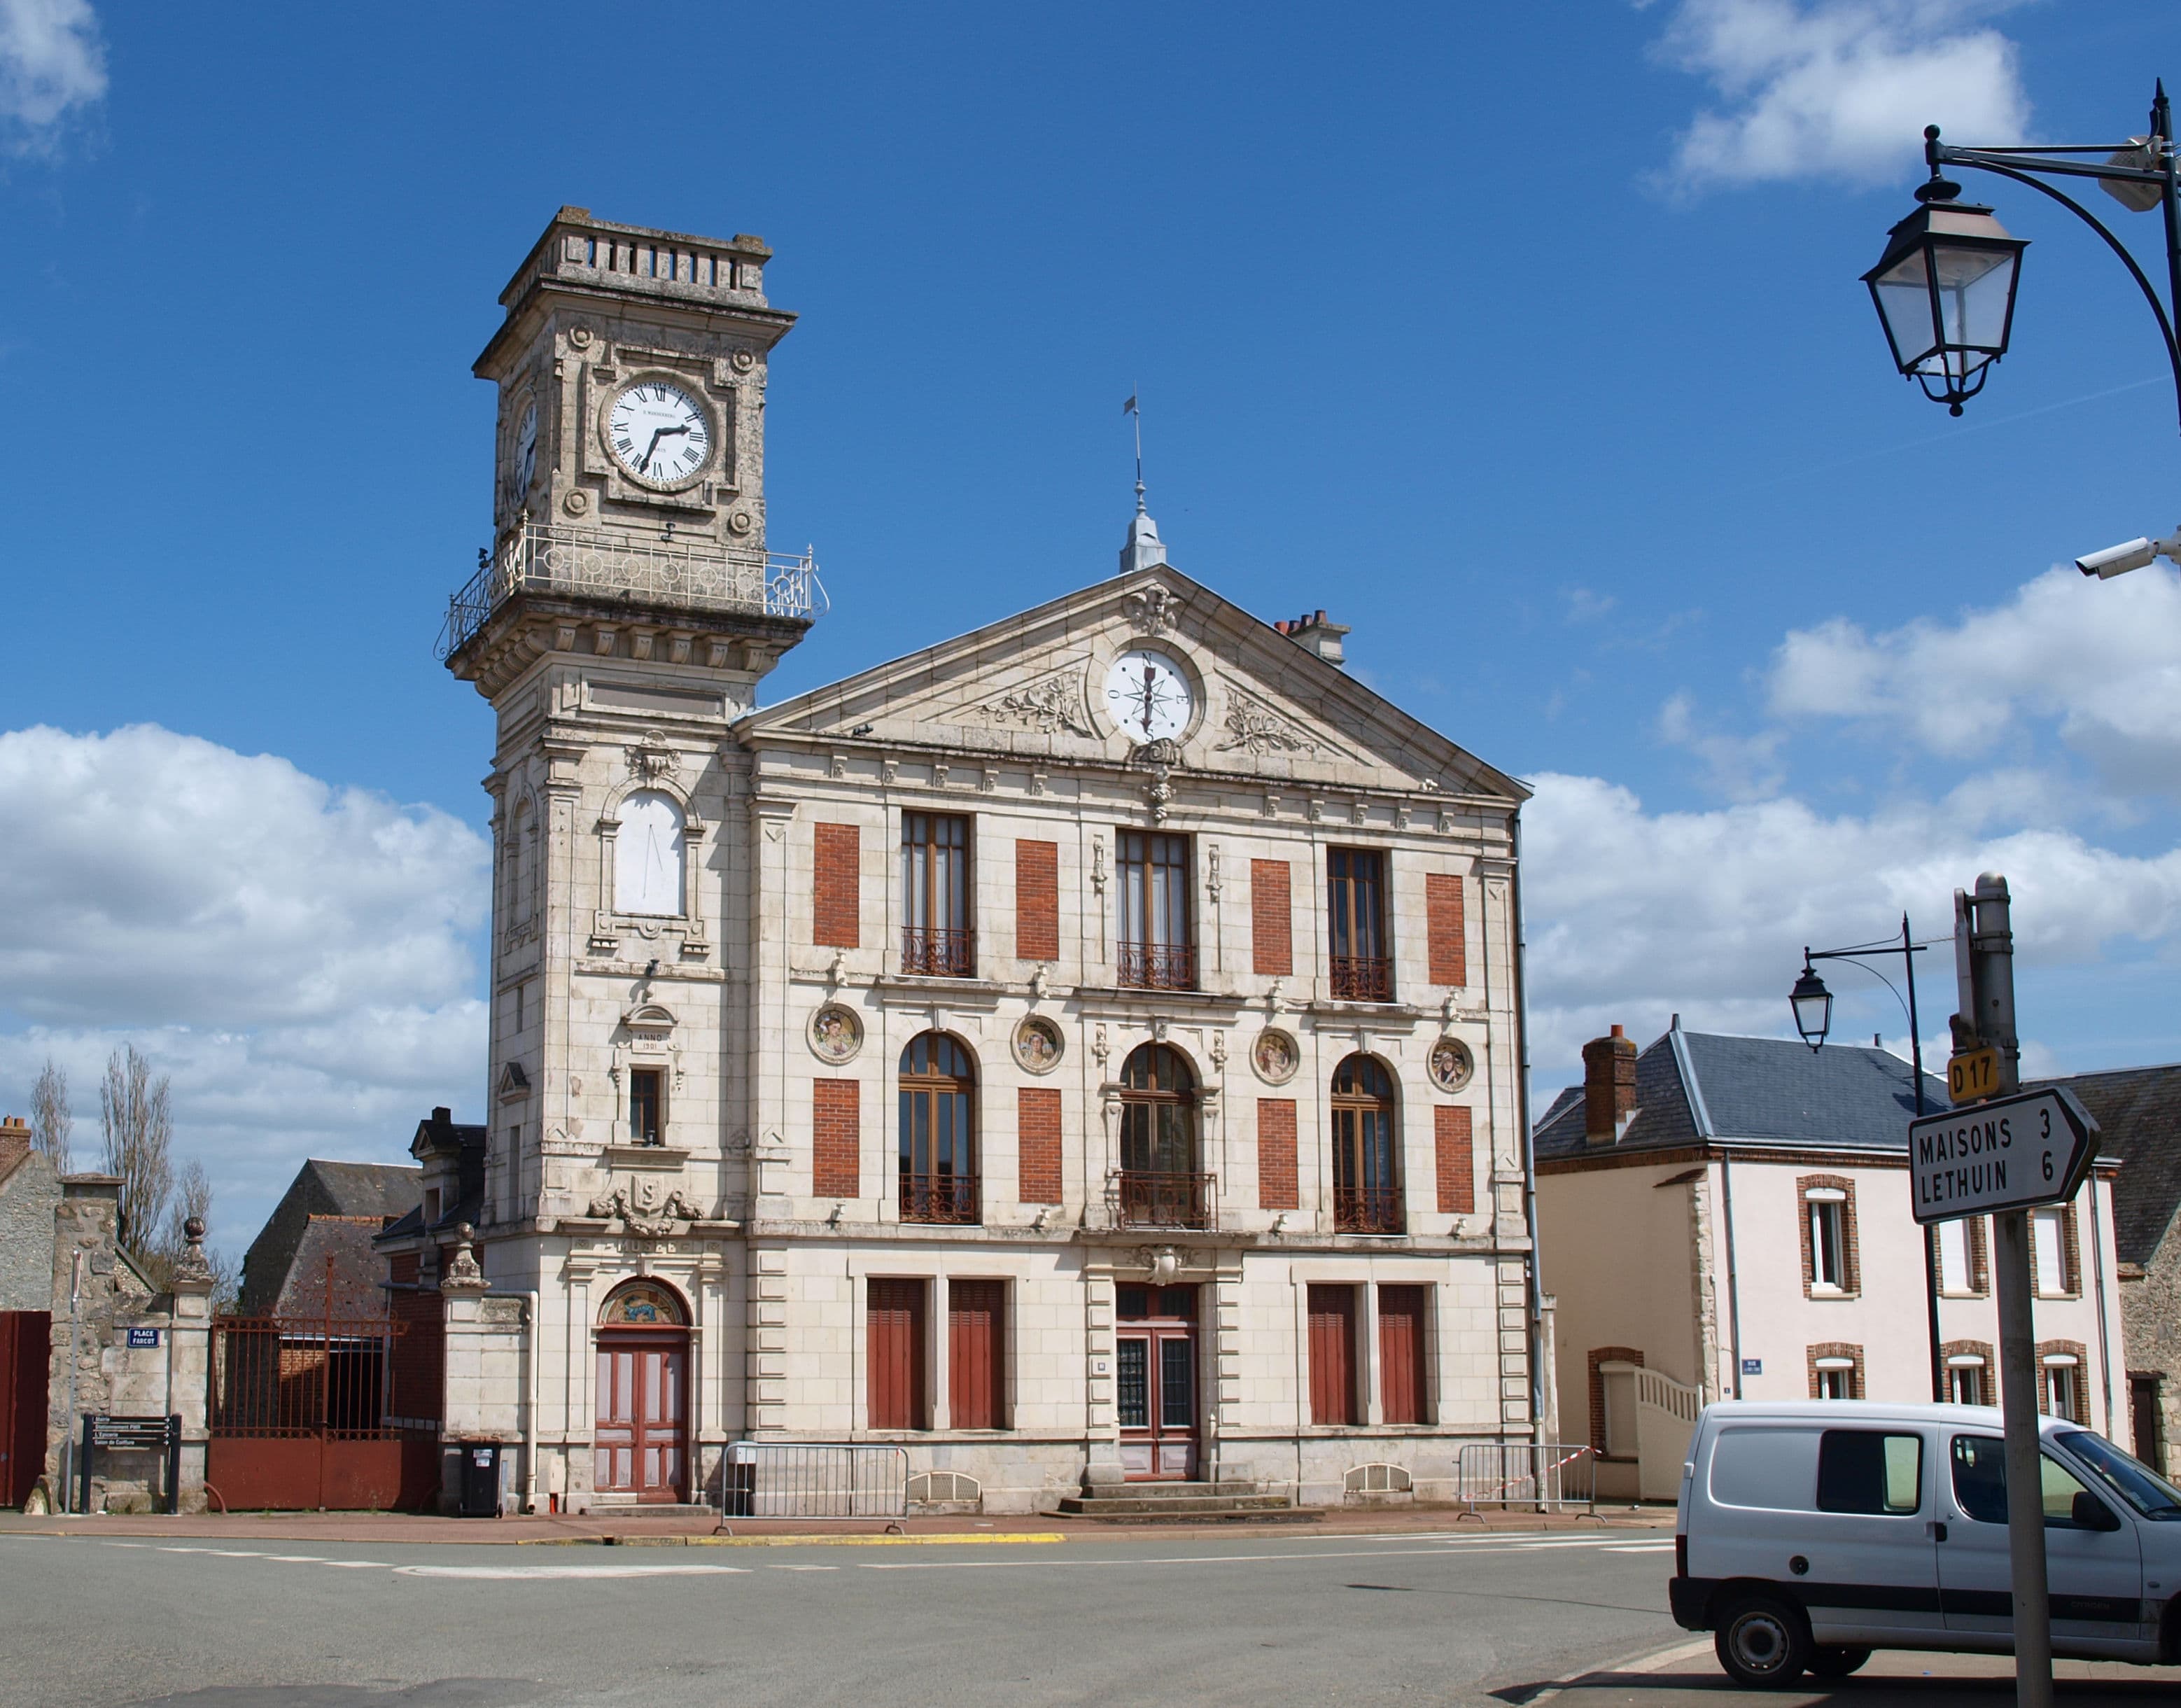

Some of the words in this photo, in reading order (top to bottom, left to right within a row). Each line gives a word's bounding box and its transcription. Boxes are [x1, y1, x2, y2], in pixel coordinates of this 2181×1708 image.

[1142, 652, 1152, 667] N
[1177, 694, 1189, 705] E
[1953, 1065, 1963, 1094] D
[1970, 1056, 1991, 1088] 17
[1919, 1118, 2012, 1166] MAISONS
[2040, 1108, 2051, 1140] 3
[1921, 1159, 2007, 1205] LETHUIN
[2042, 1150, 2054, 1182] 6
